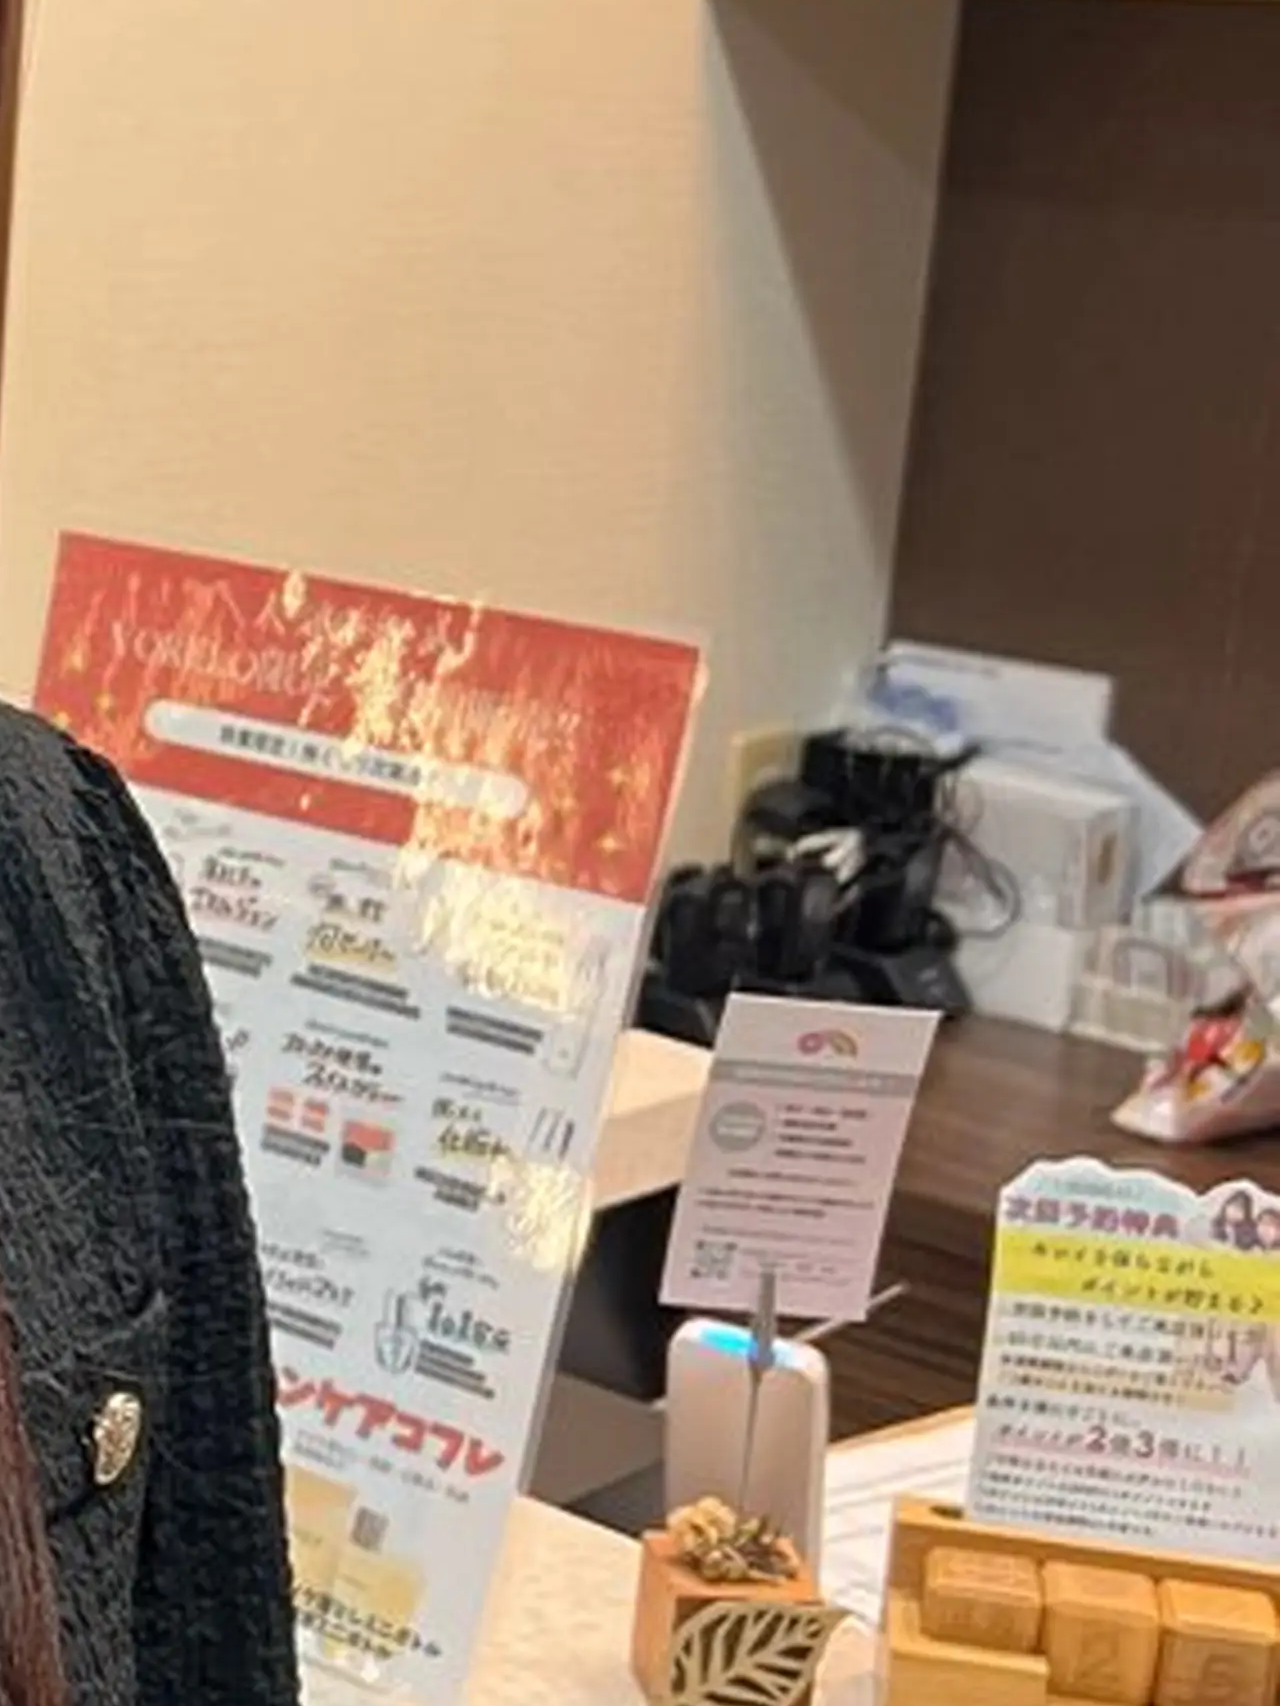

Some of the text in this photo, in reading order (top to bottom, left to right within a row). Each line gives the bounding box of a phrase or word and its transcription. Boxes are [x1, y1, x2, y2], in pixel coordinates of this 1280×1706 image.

[1006, 1195, 1179, 1238] 次回予約特典
